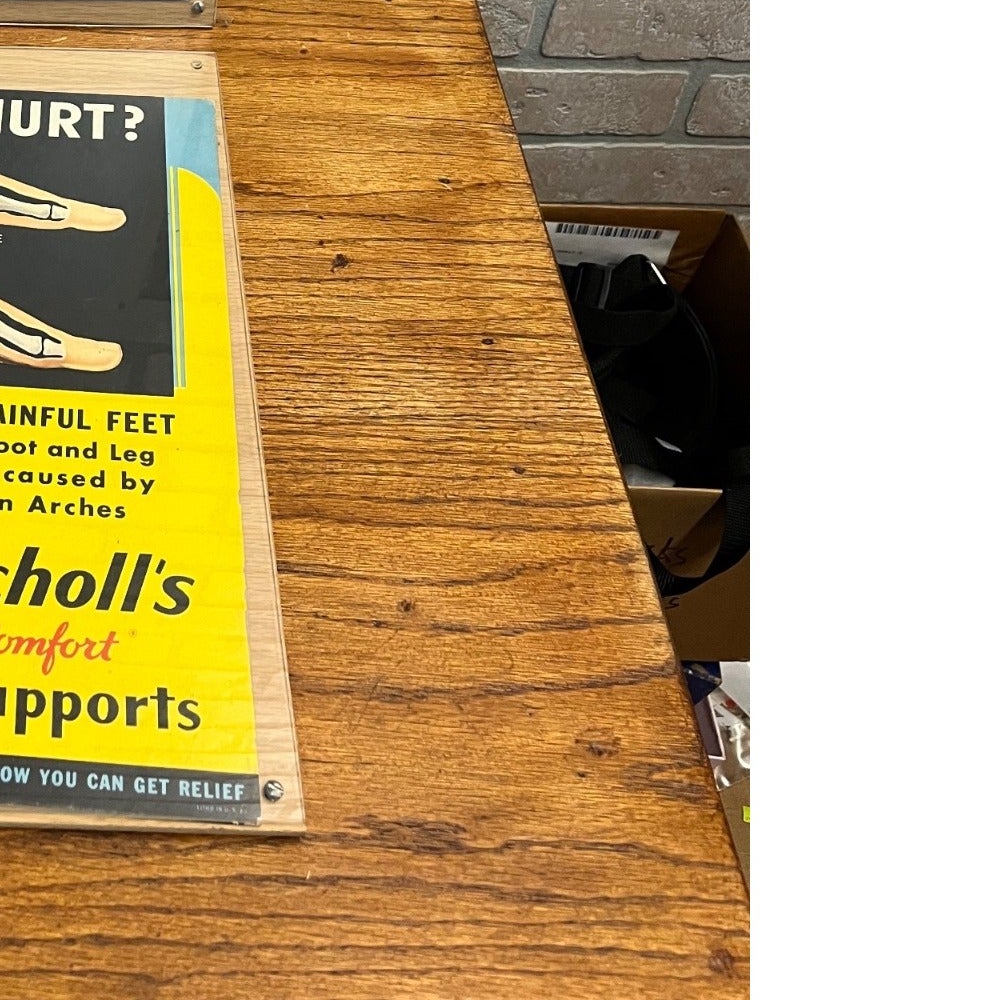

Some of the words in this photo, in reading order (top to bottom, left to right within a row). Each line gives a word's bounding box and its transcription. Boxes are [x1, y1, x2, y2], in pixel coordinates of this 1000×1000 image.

[107, 412, 176, 435] FEET
[48, 441, 98, 460] and
[110, 445, 155, 466] Leg
[4, 468, 105, 488] caused
[121, 473, 155, 495] by
[29, 496, 126, 519] Arches
[39, 767, 79, 788] YOU
[86, 772, 124, 791] CAN
[133, 776, 170, 795] GET
[178, 779, 244, 800] RELIEF
